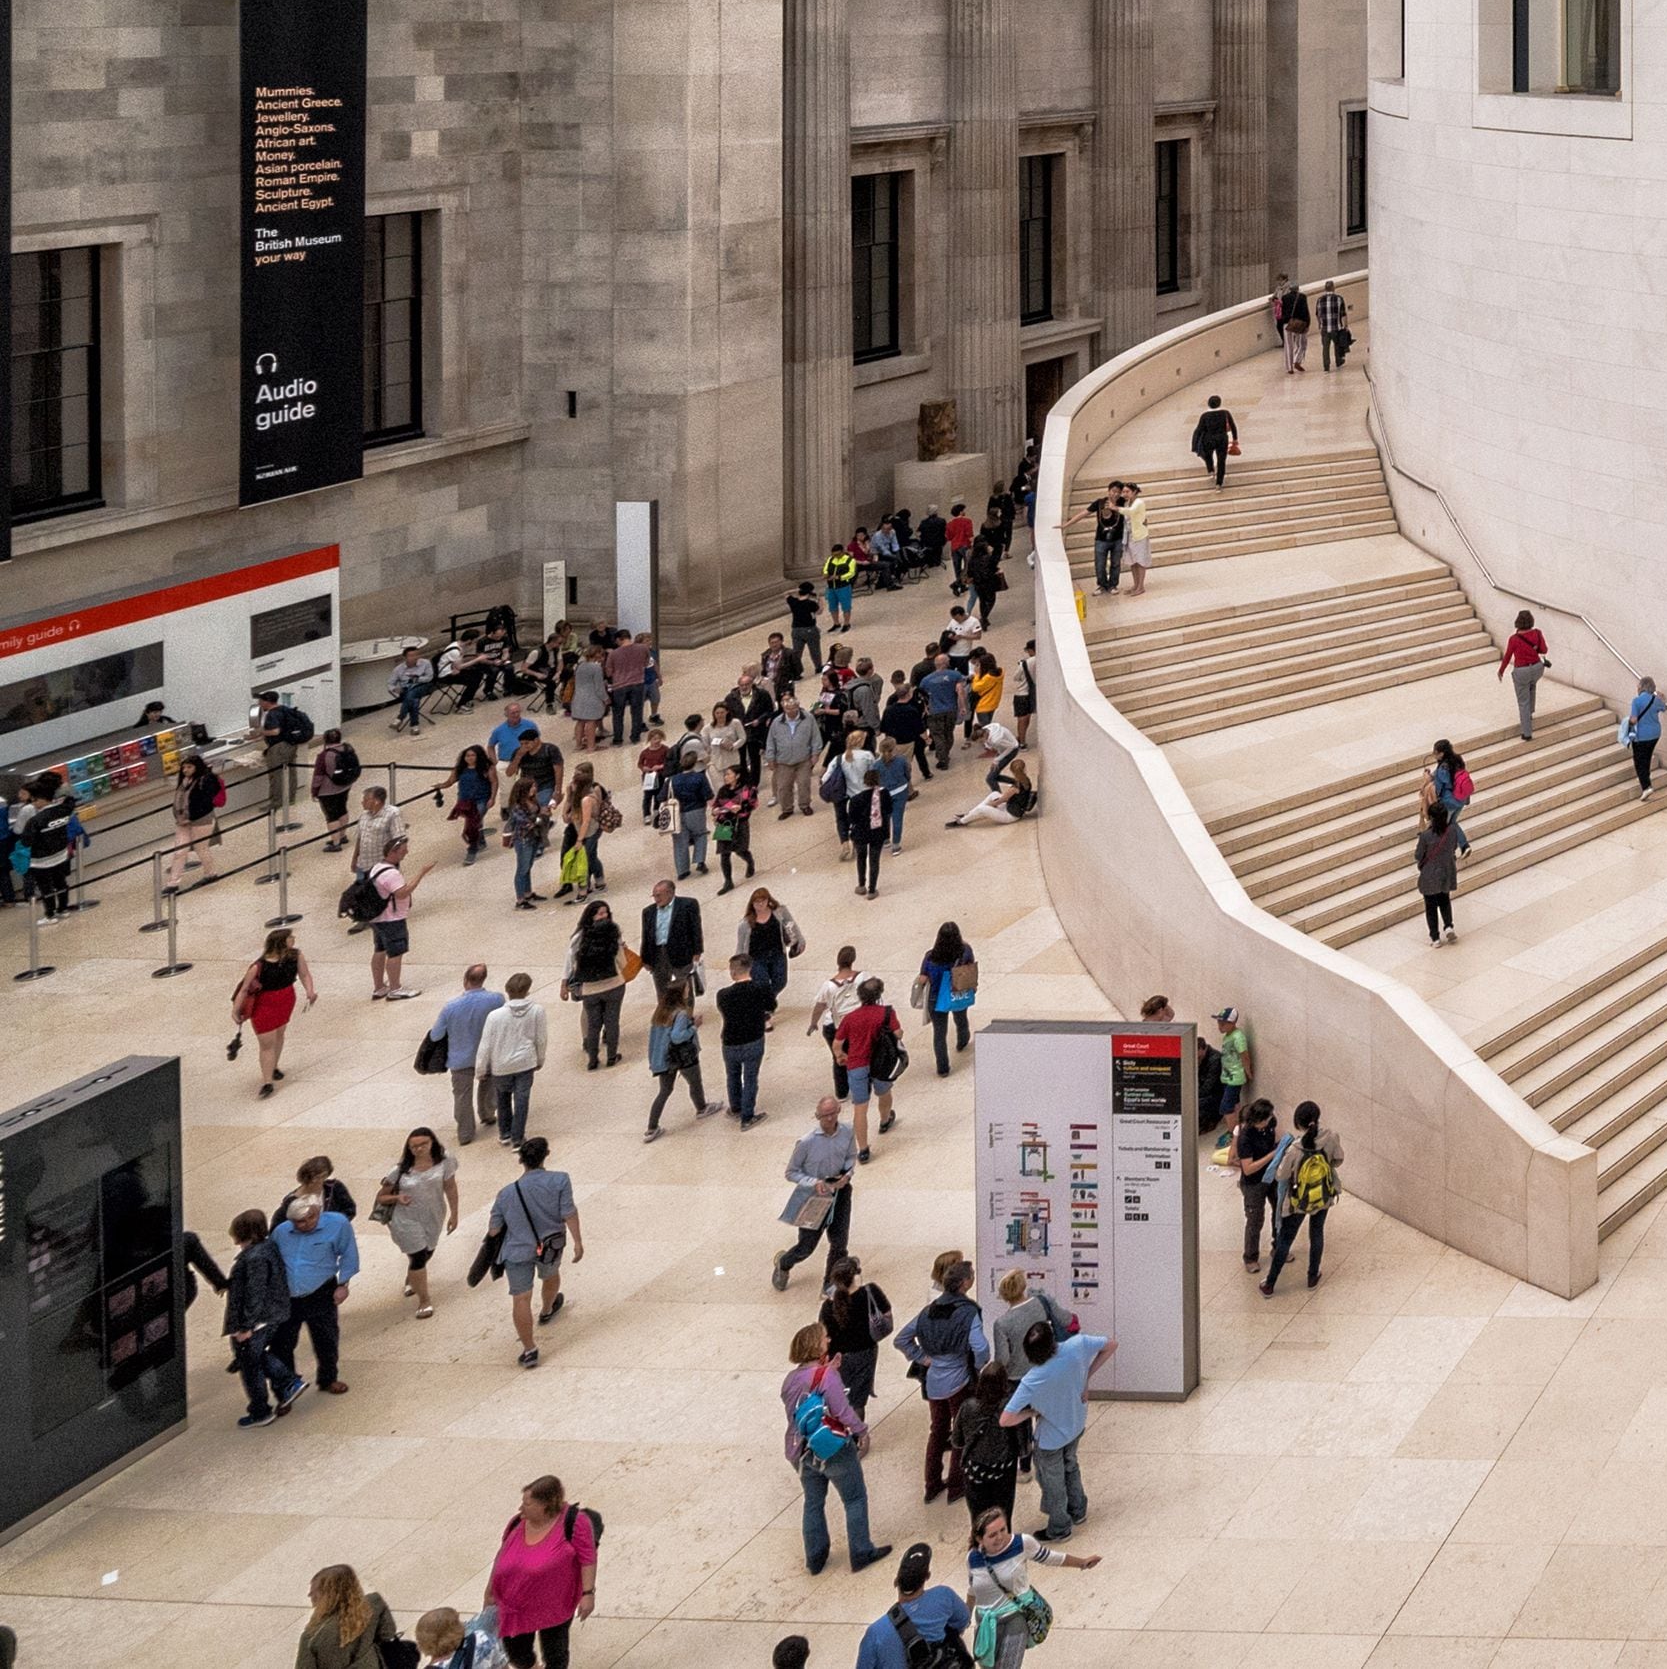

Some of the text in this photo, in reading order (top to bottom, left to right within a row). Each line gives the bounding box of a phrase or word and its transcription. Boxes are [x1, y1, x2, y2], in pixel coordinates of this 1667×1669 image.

[255, 86, 315, 98] Mummies.
[255, 98, 343, 111] Ancient Greece.
[255, 112, 310, 124] Jewellery.
[255, 123, 336, 137] Anglo-Saxons.
[255, 136, 317, 149] African art.
[255, 151, 296, 162] Money.
[255, 159, 343, 175] Asian porcelain.
[255, 172, 340, 187] Roman Empire.
[255, 187, 313, 200] Sculpture.
[254, 197, 335, 213] Ancient Egypt.
[254, 228, 279, 239] The
[255, 234, 342, 252] British Museum
[254, 251, 307, 266] your way
[255, 375, 319, 405] Audio
[255, 397, 317, 431] guide
[26, 626, 64, 646] guide
